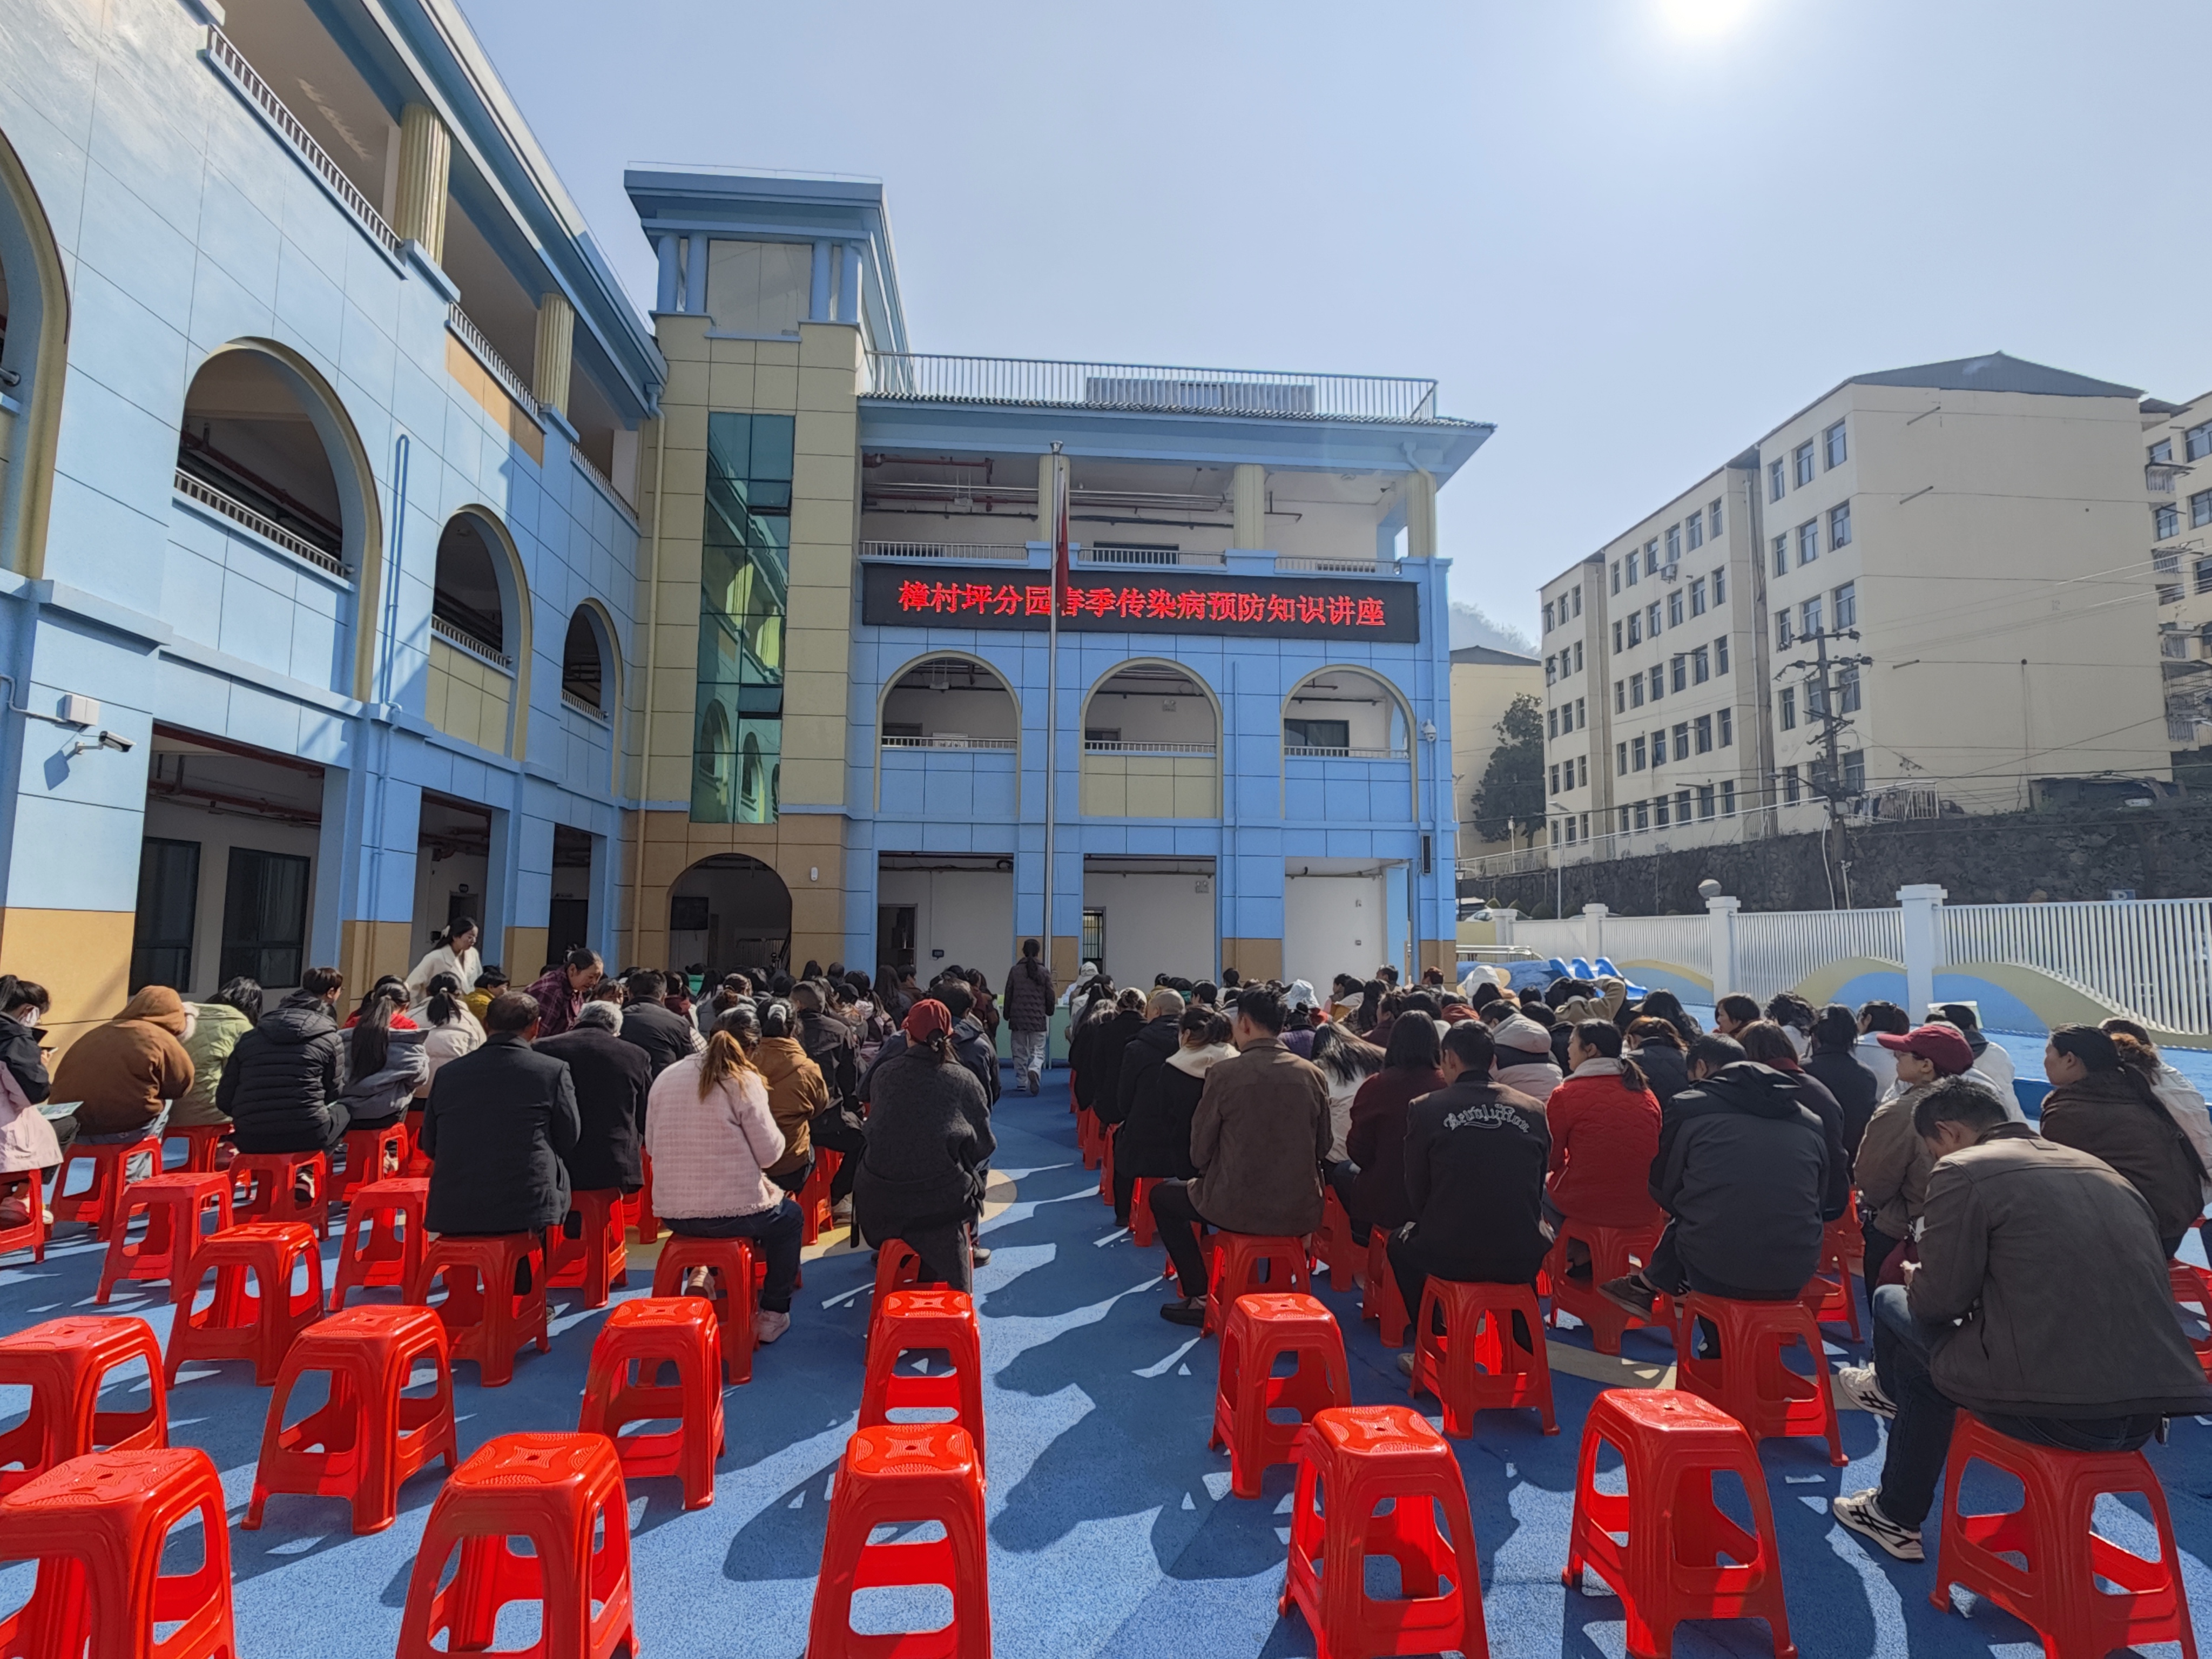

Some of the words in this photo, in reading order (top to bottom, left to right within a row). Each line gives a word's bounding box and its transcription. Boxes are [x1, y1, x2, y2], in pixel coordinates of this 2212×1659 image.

[898, 581, 1386, 625] 樟村坪分园春季传染病预防知识讲座
